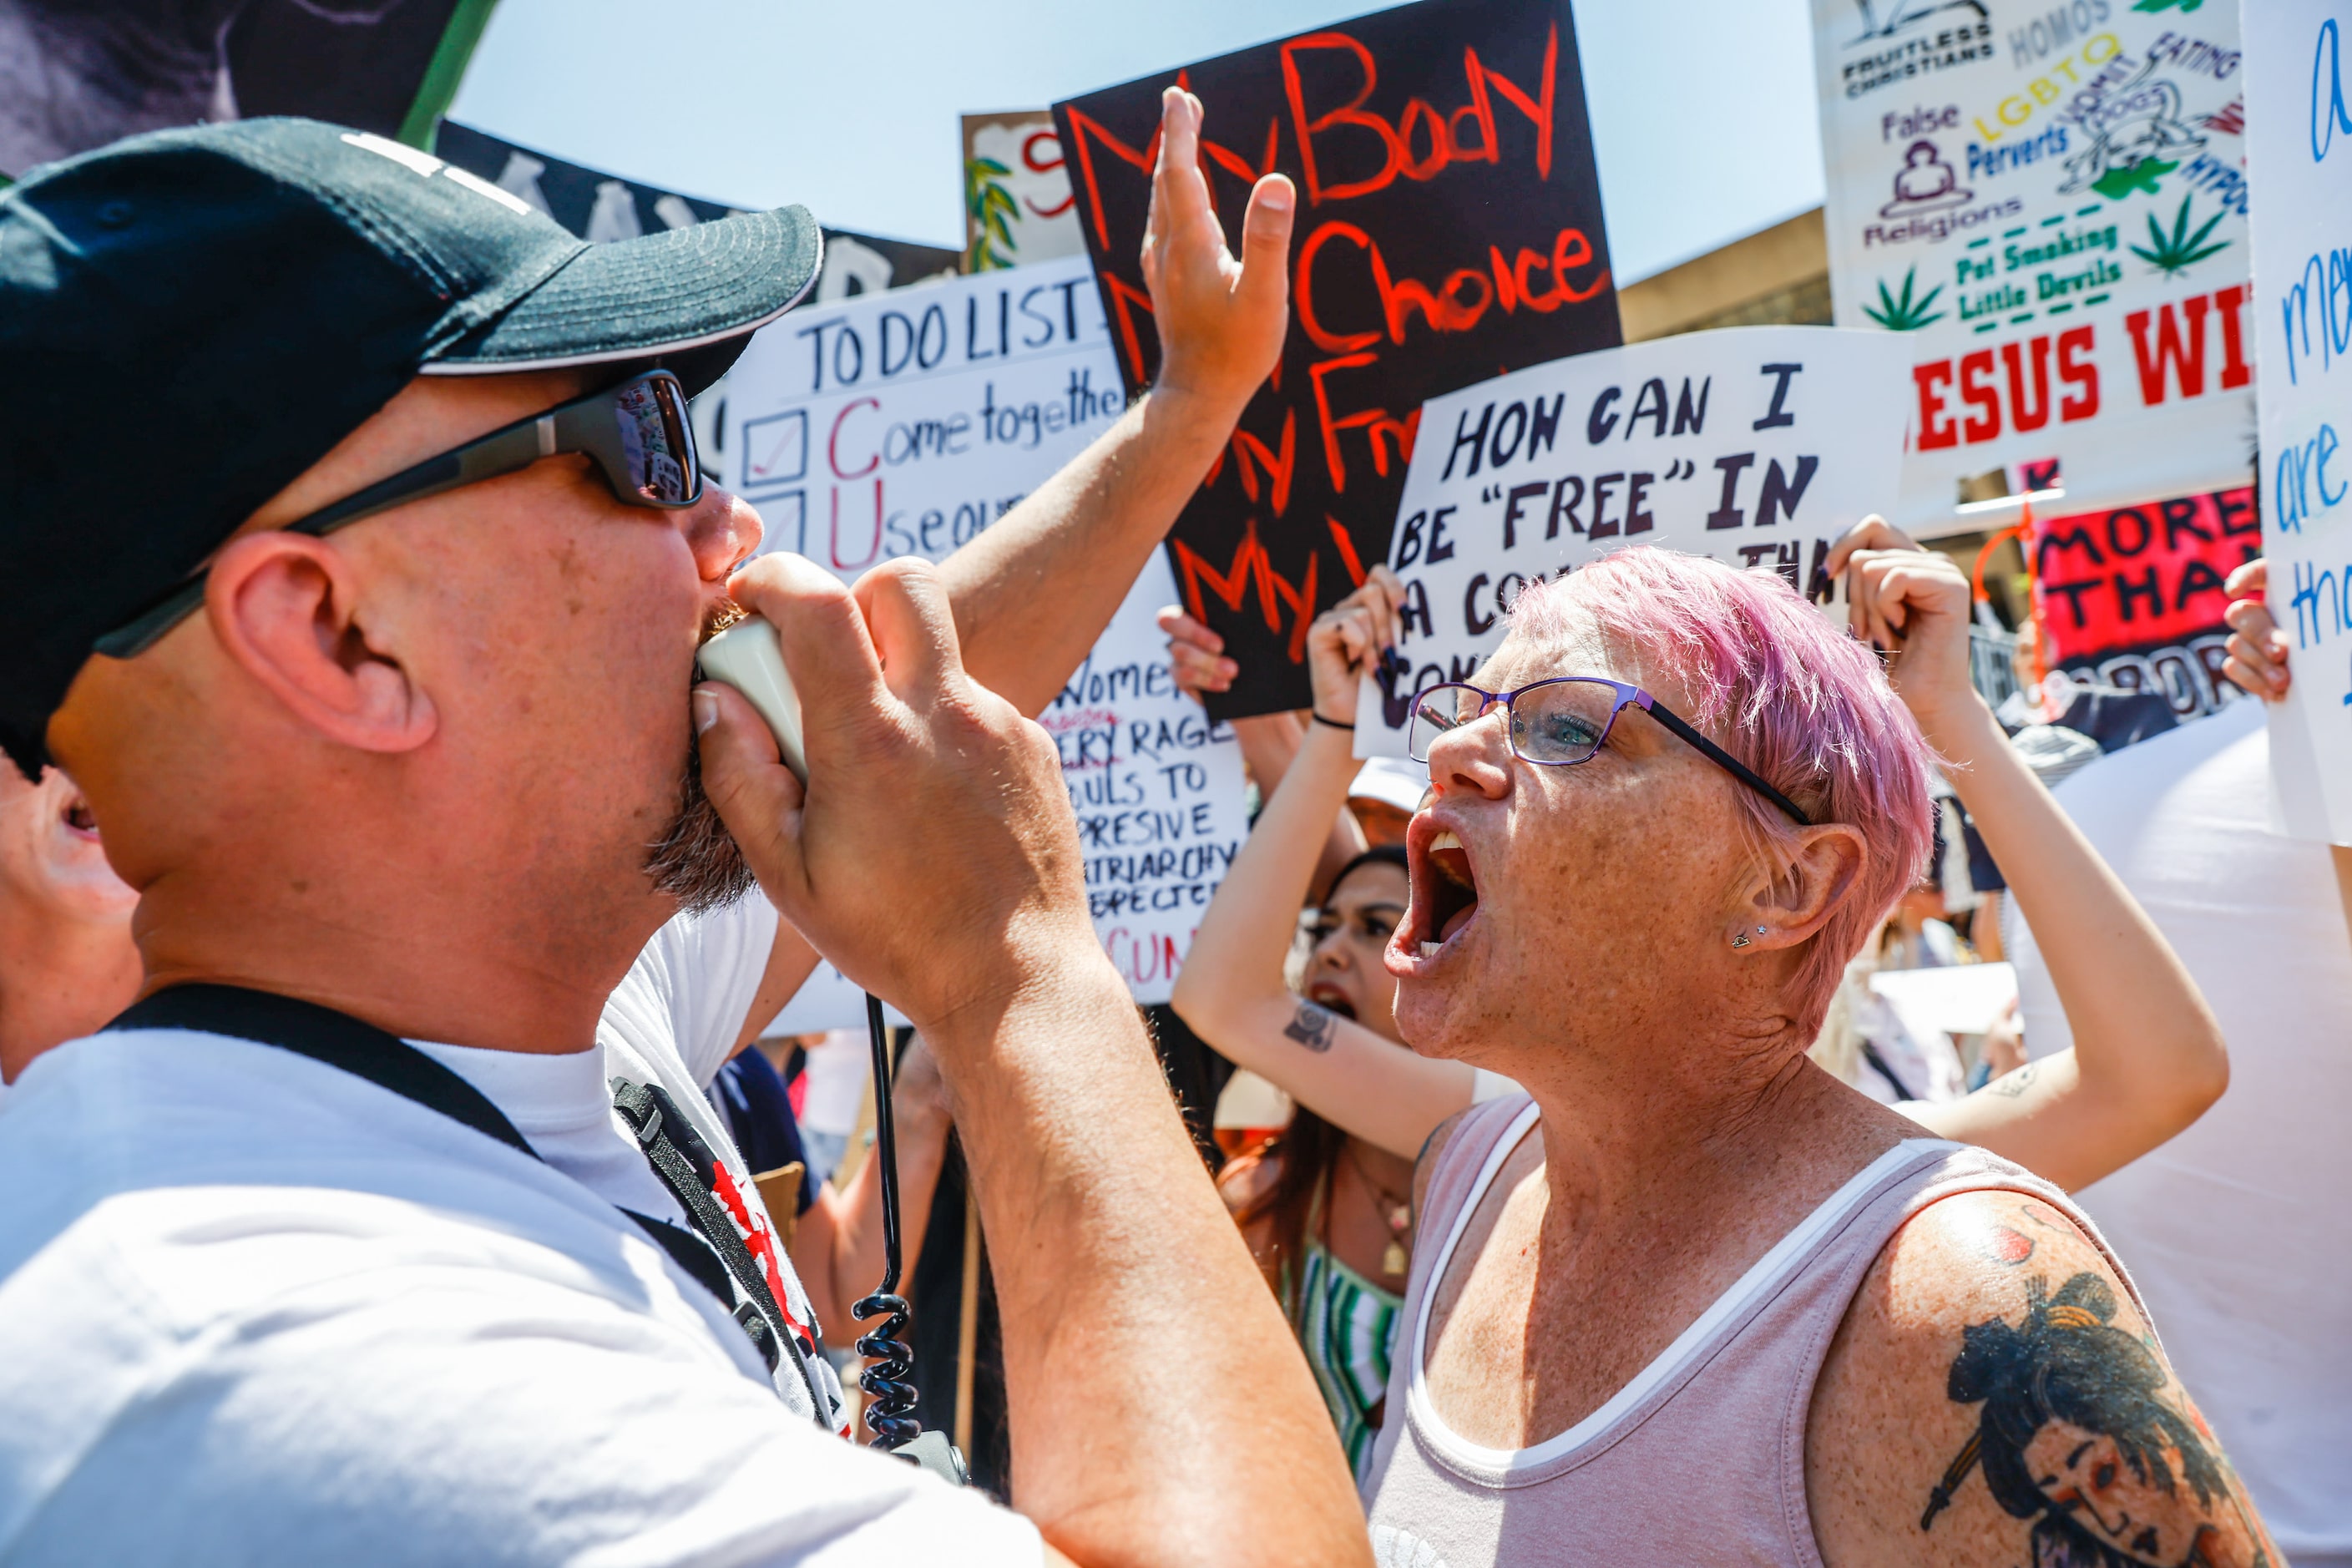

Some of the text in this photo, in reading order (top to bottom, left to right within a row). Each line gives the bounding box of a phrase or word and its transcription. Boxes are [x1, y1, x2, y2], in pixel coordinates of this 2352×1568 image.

[1842, 23, 1991, 81] FRUITLESS
[1844, 43, 1994, 99] CHRISTIANS
[2146, 31, 2242, 79] EATING
[1972, 33, 2122, 142] LGBTQ
[1882, 104, 1960, 142] False
[1967, 125, 2070, 181] Perverts
[1863, 197, 2023, 248] Religions
[2003, 223, 2118, 272] Smoking
[1958, 258, 2122, 321] Little Devils
[795, 315, 863, 393] TO
[878, 304, 949, 377] DO
[1904, 282, 2254, 453] ESUS WI
[1587, 375, 1711, 446] CAN
[1753, 363, 1803, 432] I
[827, 397, 972, 481] Come
[2273, 422, 2348, 534] are
[1395, 506, 1457, 571] BE
[1707, 452, 1819, 532] IN
[2037, 490, 2258, 578] MORE
[2043, 543, 2261, 629] THA
[1130, 714, 1236, 763] RAGE
[1158, 761, 1208, 800] TO
[1084, 841, 1238, 886] TRIARCHY
